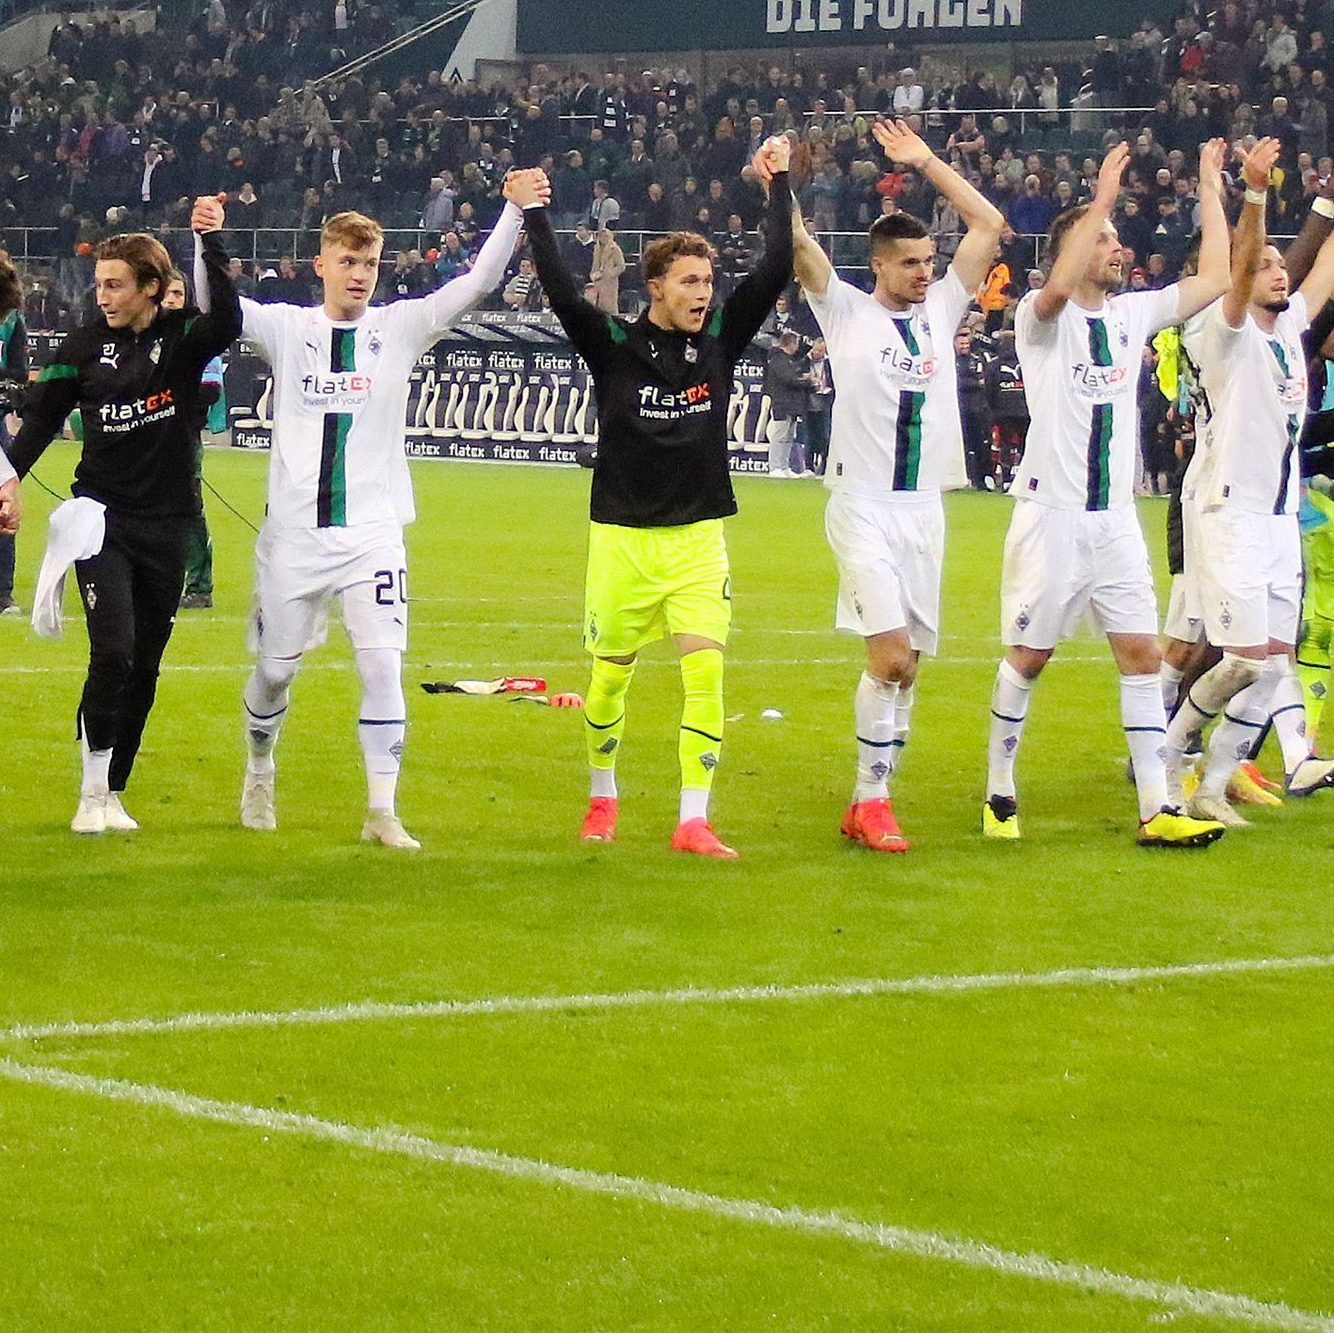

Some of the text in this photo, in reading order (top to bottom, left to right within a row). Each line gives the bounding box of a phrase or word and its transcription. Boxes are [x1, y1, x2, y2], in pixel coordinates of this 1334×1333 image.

[102, 342, 116, 356] 27
[446, 352, 483, 367] flatex
[488, 354, 525, 369] flatex
[534, 355, 572, 370] flatex
[733, 362, 764, 377] atex
[638, 382, 711, 407] flatex
[99, 389, 174, 422] flatex
[141, 406, 176, 427] yourself
[639, 407, 670, 420] invest
[236, 432, 270, 447] flatex
[449, 442, 485, 458] flatex
[493, 444, 530, 459] flatex
[538, 446, 577, 462] flatex
